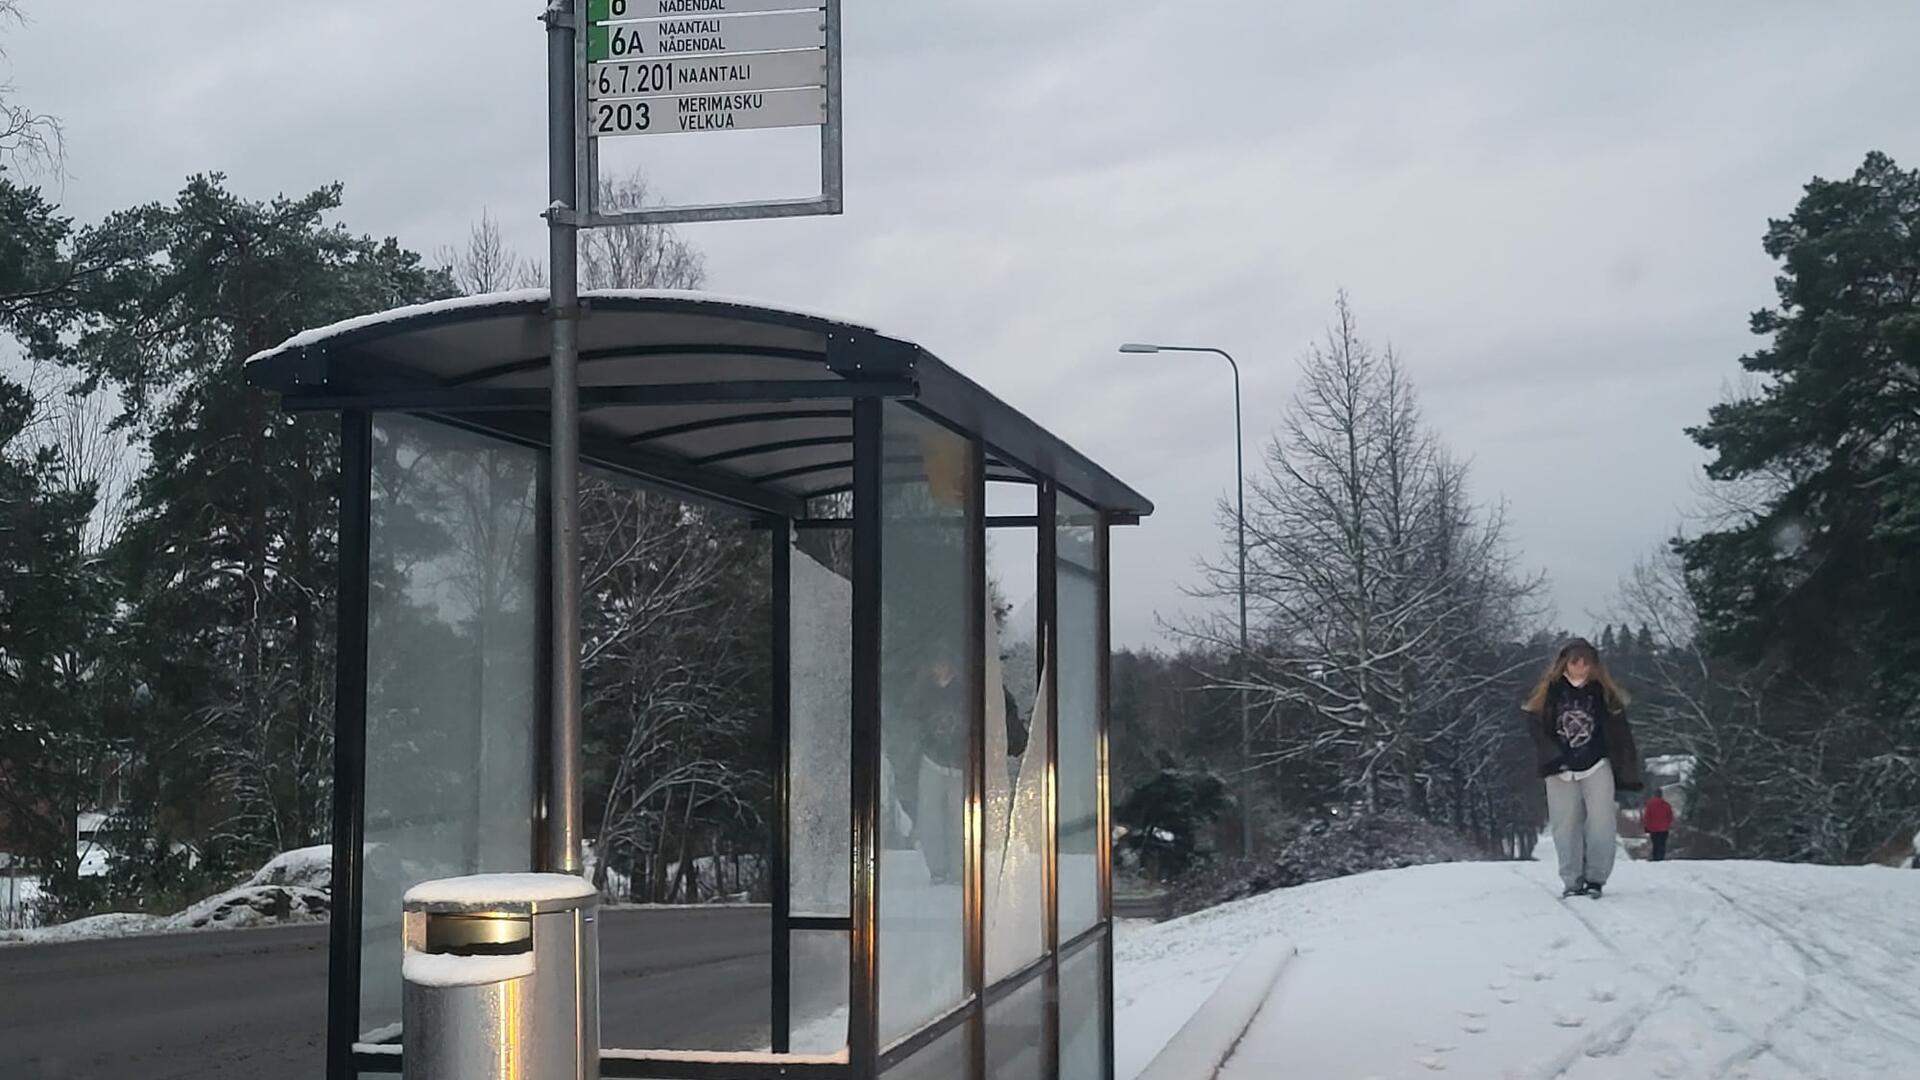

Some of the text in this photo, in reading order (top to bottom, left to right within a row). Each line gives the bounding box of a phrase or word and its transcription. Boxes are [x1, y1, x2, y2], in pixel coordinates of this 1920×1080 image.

[659, 20, 720, 36] NAANTALI
[611, 27, 644, 56] 6A
[598, 63, 751, 94] 6.7.201 NAANTALI
[678, 94, 763, 112] MERIMASKU
[598, 102, 651, 132] 203
[679, 112, 735, 130] VELKUA
